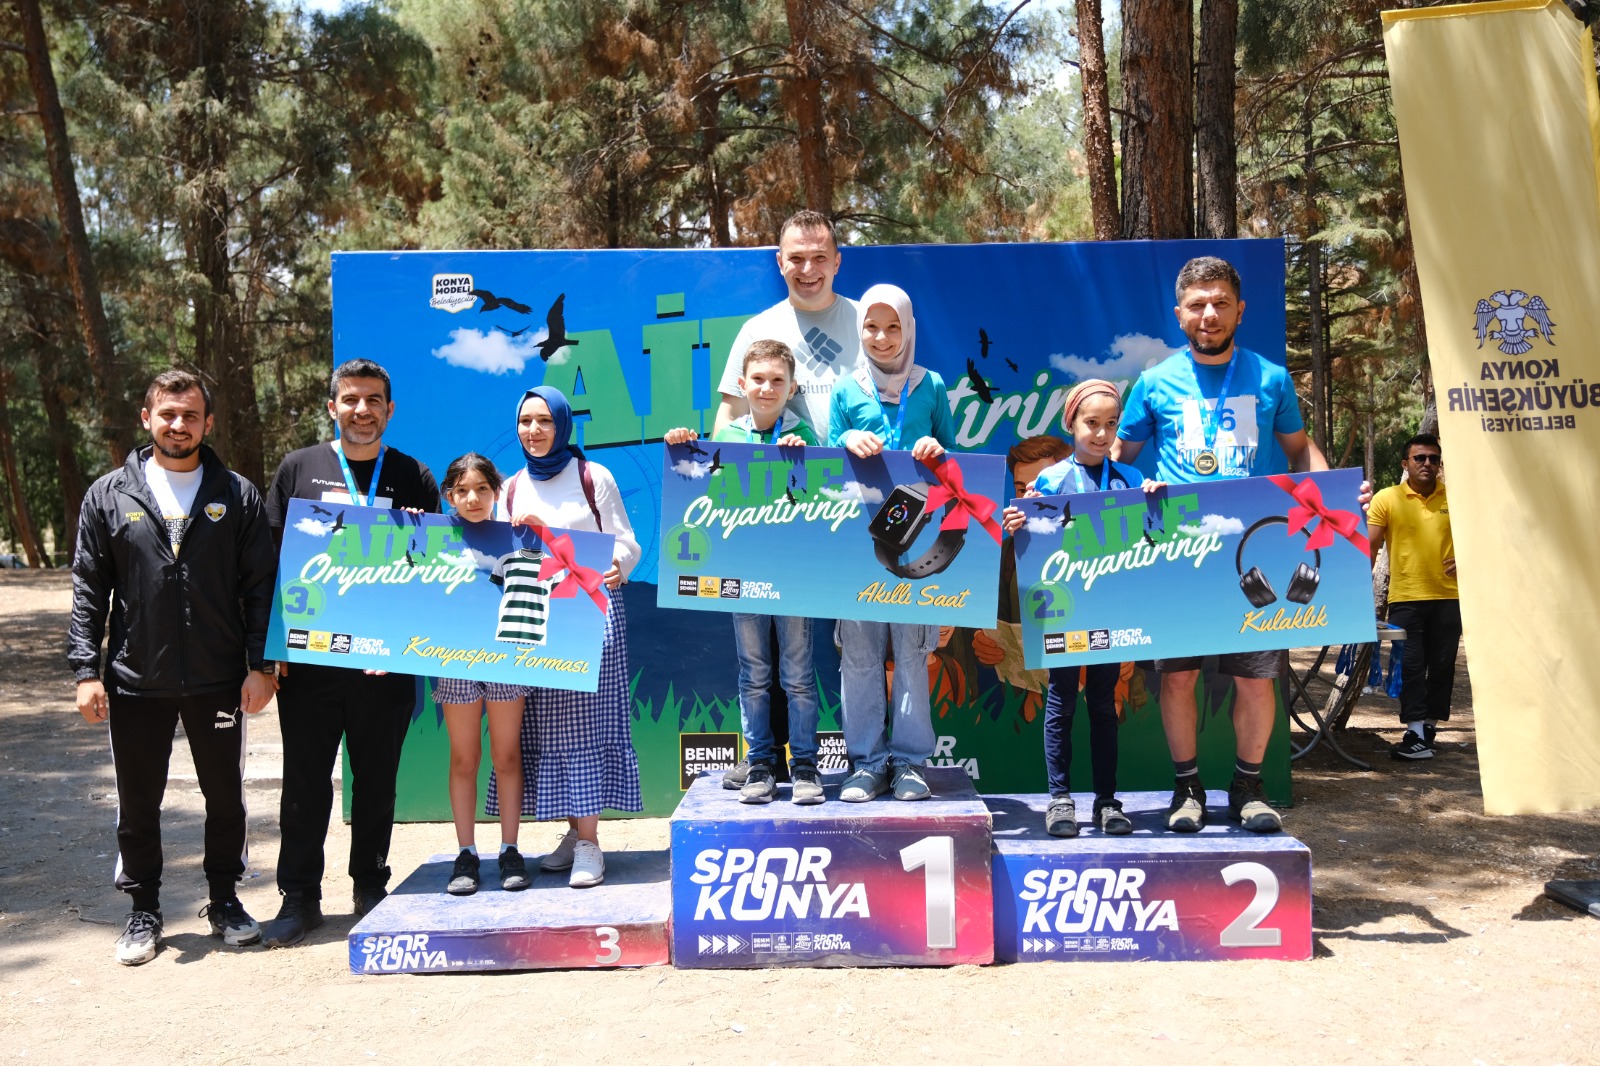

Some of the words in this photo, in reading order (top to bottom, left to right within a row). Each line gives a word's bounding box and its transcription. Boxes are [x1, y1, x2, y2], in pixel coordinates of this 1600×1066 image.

[436, 277, 470, 287] KONYA
[677, 531, 700, 561] 1.
[742, 581, 773, 590] SPOR
[742, 588, 781, 600] KONYA
[916, 584, 971, 608] Saat
[285, 586, 315, 616] 3.
[1033, 589, 1065, 619] 2.
[352, 637, 384, 647] SPOR
[1110, 628, 1142, 639] SPOR
[1112, 635, 1152, 647] KONYA
[352, 645, 390, 656] KONYA
[402, 636, 508, 669] Konyaspor
[215, 720, 234, 729] PUMA
[689, 847, 832, 885] SPOR
[899, 835, 956, 949] 1
[1019, 868, 1146, 900] SPOR
[693, 873, 871, 921] KONYA
[1220, 861, 1281, 947] 2
[1022, 891, 1179, 933] KONYA
[361, 934, 429, 953] SPOR
[594, 926, 622, 965] 3
[813, 934, 843, 942] SPOR
[814, 940, 851, 950] KONYA
[364, 947, 448, 971] KONYA
